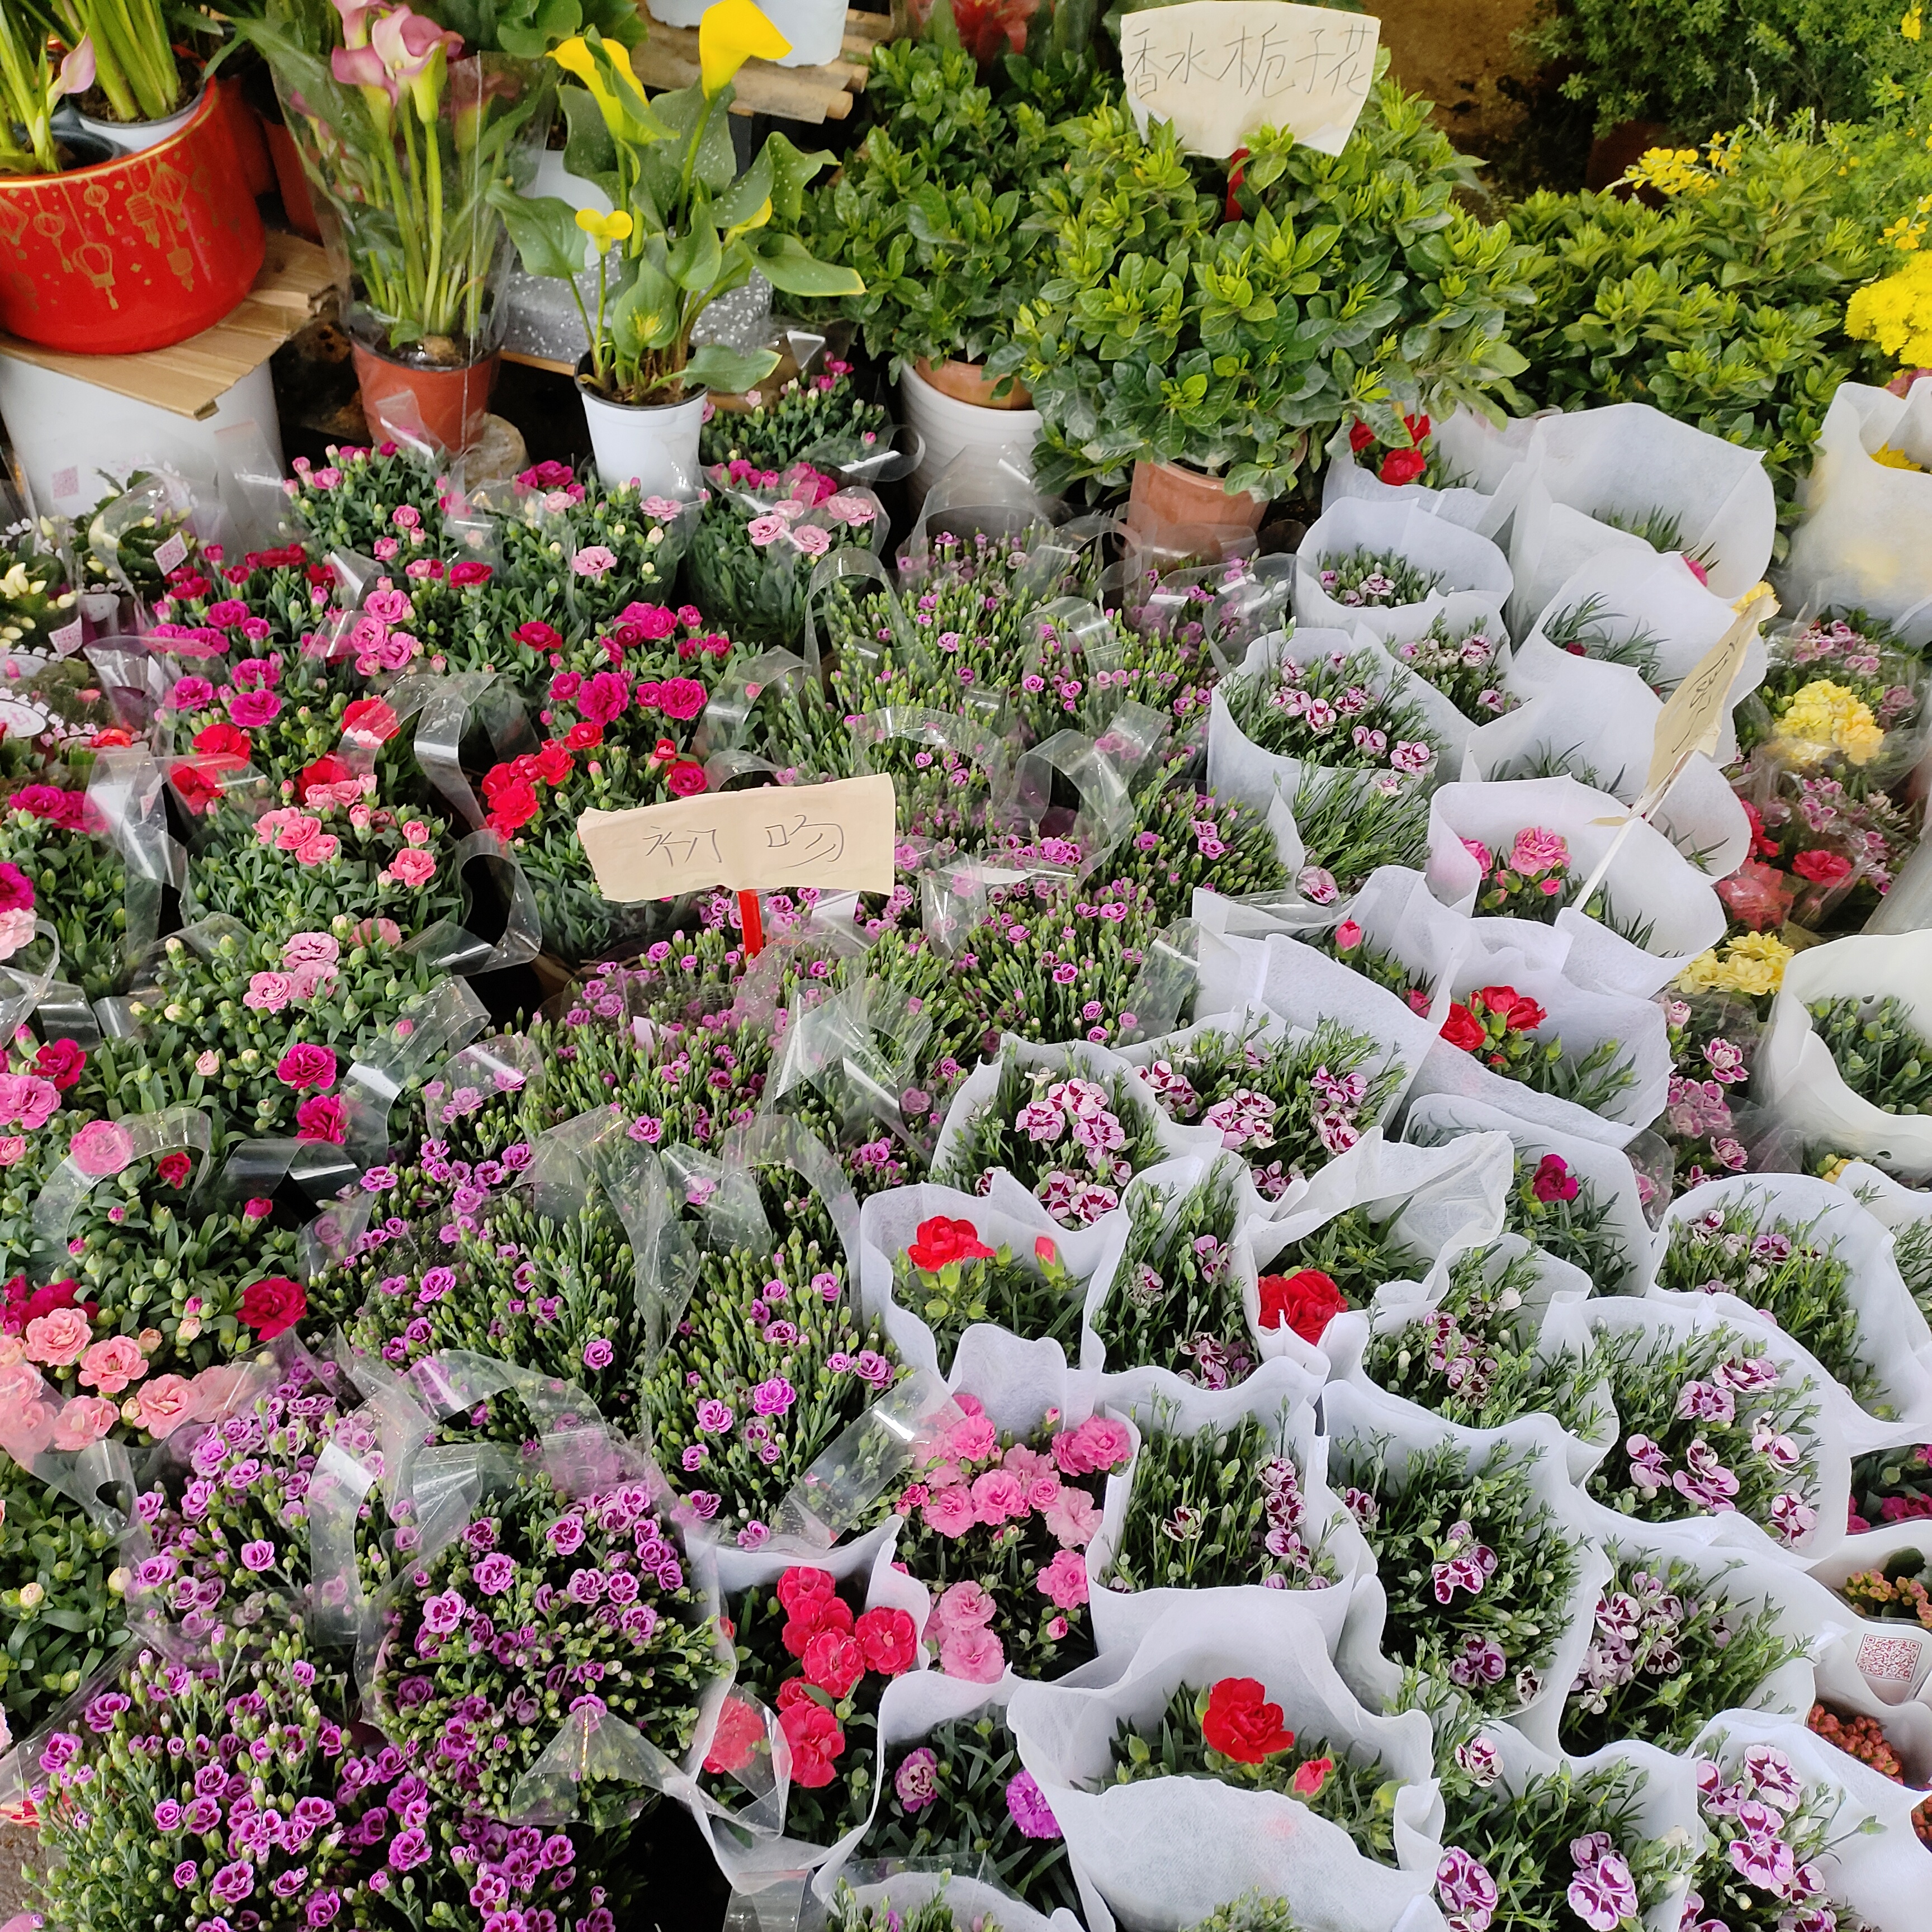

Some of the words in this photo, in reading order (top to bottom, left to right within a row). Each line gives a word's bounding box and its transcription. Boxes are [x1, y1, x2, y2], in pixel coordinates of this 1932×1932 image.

[1129, 22, 1374, 100] 香水栀子花
